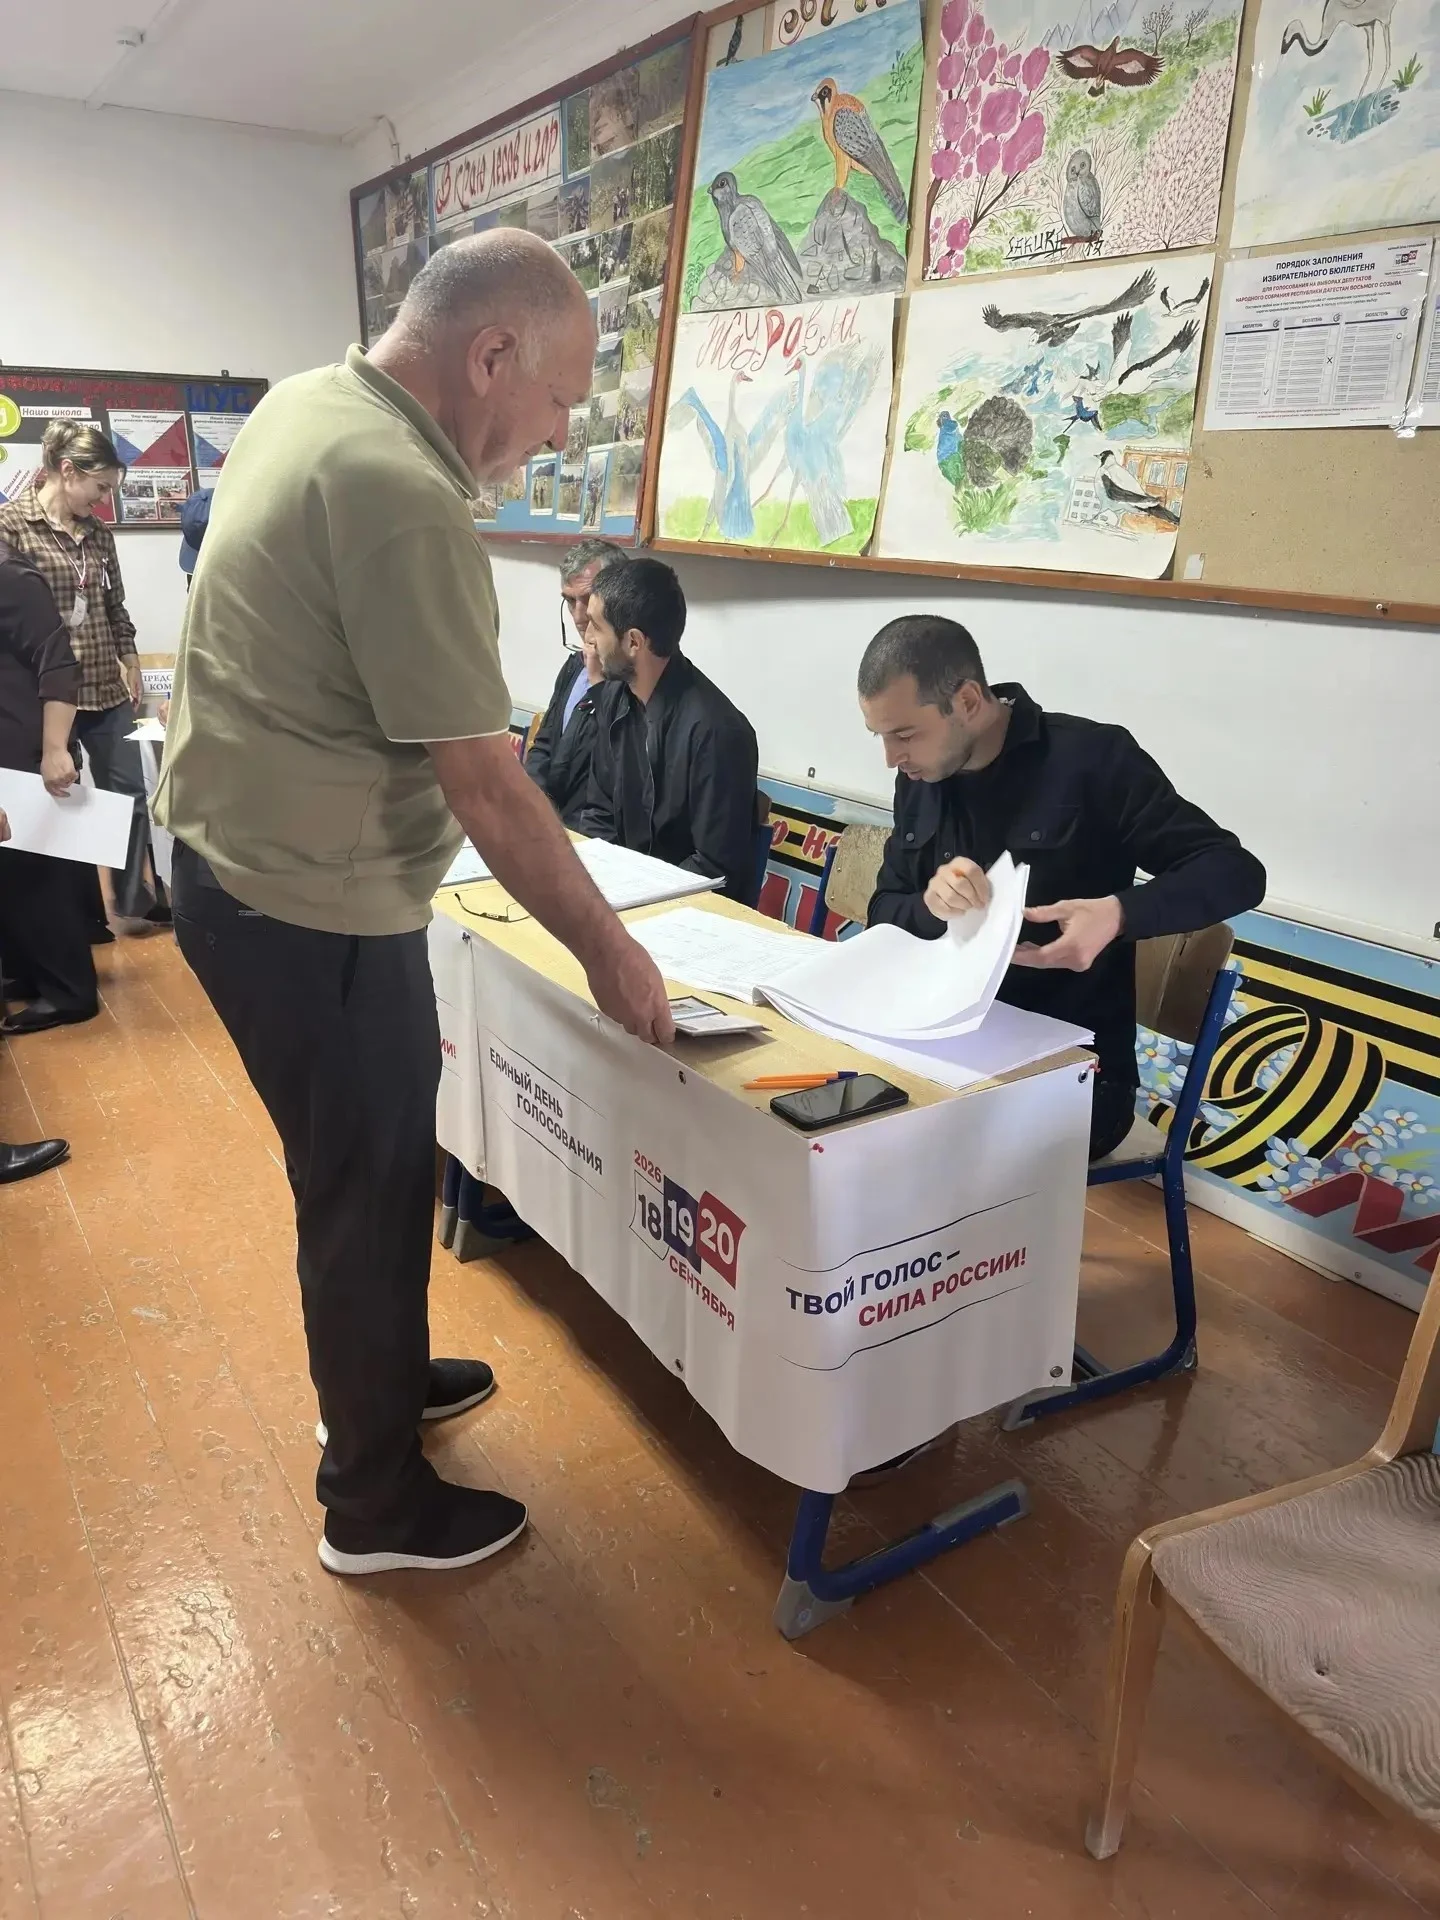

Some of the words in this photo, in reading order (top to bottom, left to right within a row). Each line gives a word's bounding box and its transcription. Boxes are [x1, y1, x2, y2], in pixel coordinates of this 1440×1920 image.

[436, 160, 451, 214] В
[487, 129, 521, 201] лесов
[523, 133, 532, 175] и
[533, 116, 559, 180] гор
[1262, 268, 1328, 283] ИЗБИРАТЕЛЬНОГО
[1329, 263, 1375, 275] БЮЛЛЕТЕНЯ
[1264, 291, 1290, 300] СОБРАНИЯ
[1290, 288, 1322, 297] РЕСПУБЛИКИ
[1322, 285, 1349, 294] ДАГЕСТАН
[1350, 282, 1379, 291] ВОСЬМОГО
[1379, 280, 1402, 288] СОЗЫВА
[1273, 282, 1309, 291] ГОЛОСОВАНИЯ
[1342, 275, 1372, 284] ДЕПУТАТОВ
[1276, 258, 1311, 270] ПОРЯДОК
[1312, 252, 1363, 265] ЗАПОЛНЕНИЯ
[22, 408, 49, 416] Наша
[490, 1047, 532, 1094] ЕДИНЫЙ
[534, 1083, 563, 1119] ДЕНЬ
[517, 1093, 603, 1175] ГОЛОСОВАНИЯ
[634, 1150, 662, 1184] 2026
[638, 1194, 662, 1241] 18
[667, 1199, 694, 1248] 19
[700, 1208, 735, 1265] 20
[669, 1255, 735, 1332] СЕНТЯБРЯ
[785, 1276, 855, 1315] ТВОЙ
[860, 1251, 942, 1296] ГОЛОС
[858, 1288, 926, 1327] СИЛА
[931, 1246, 1027, 1302] РОССИИ!
